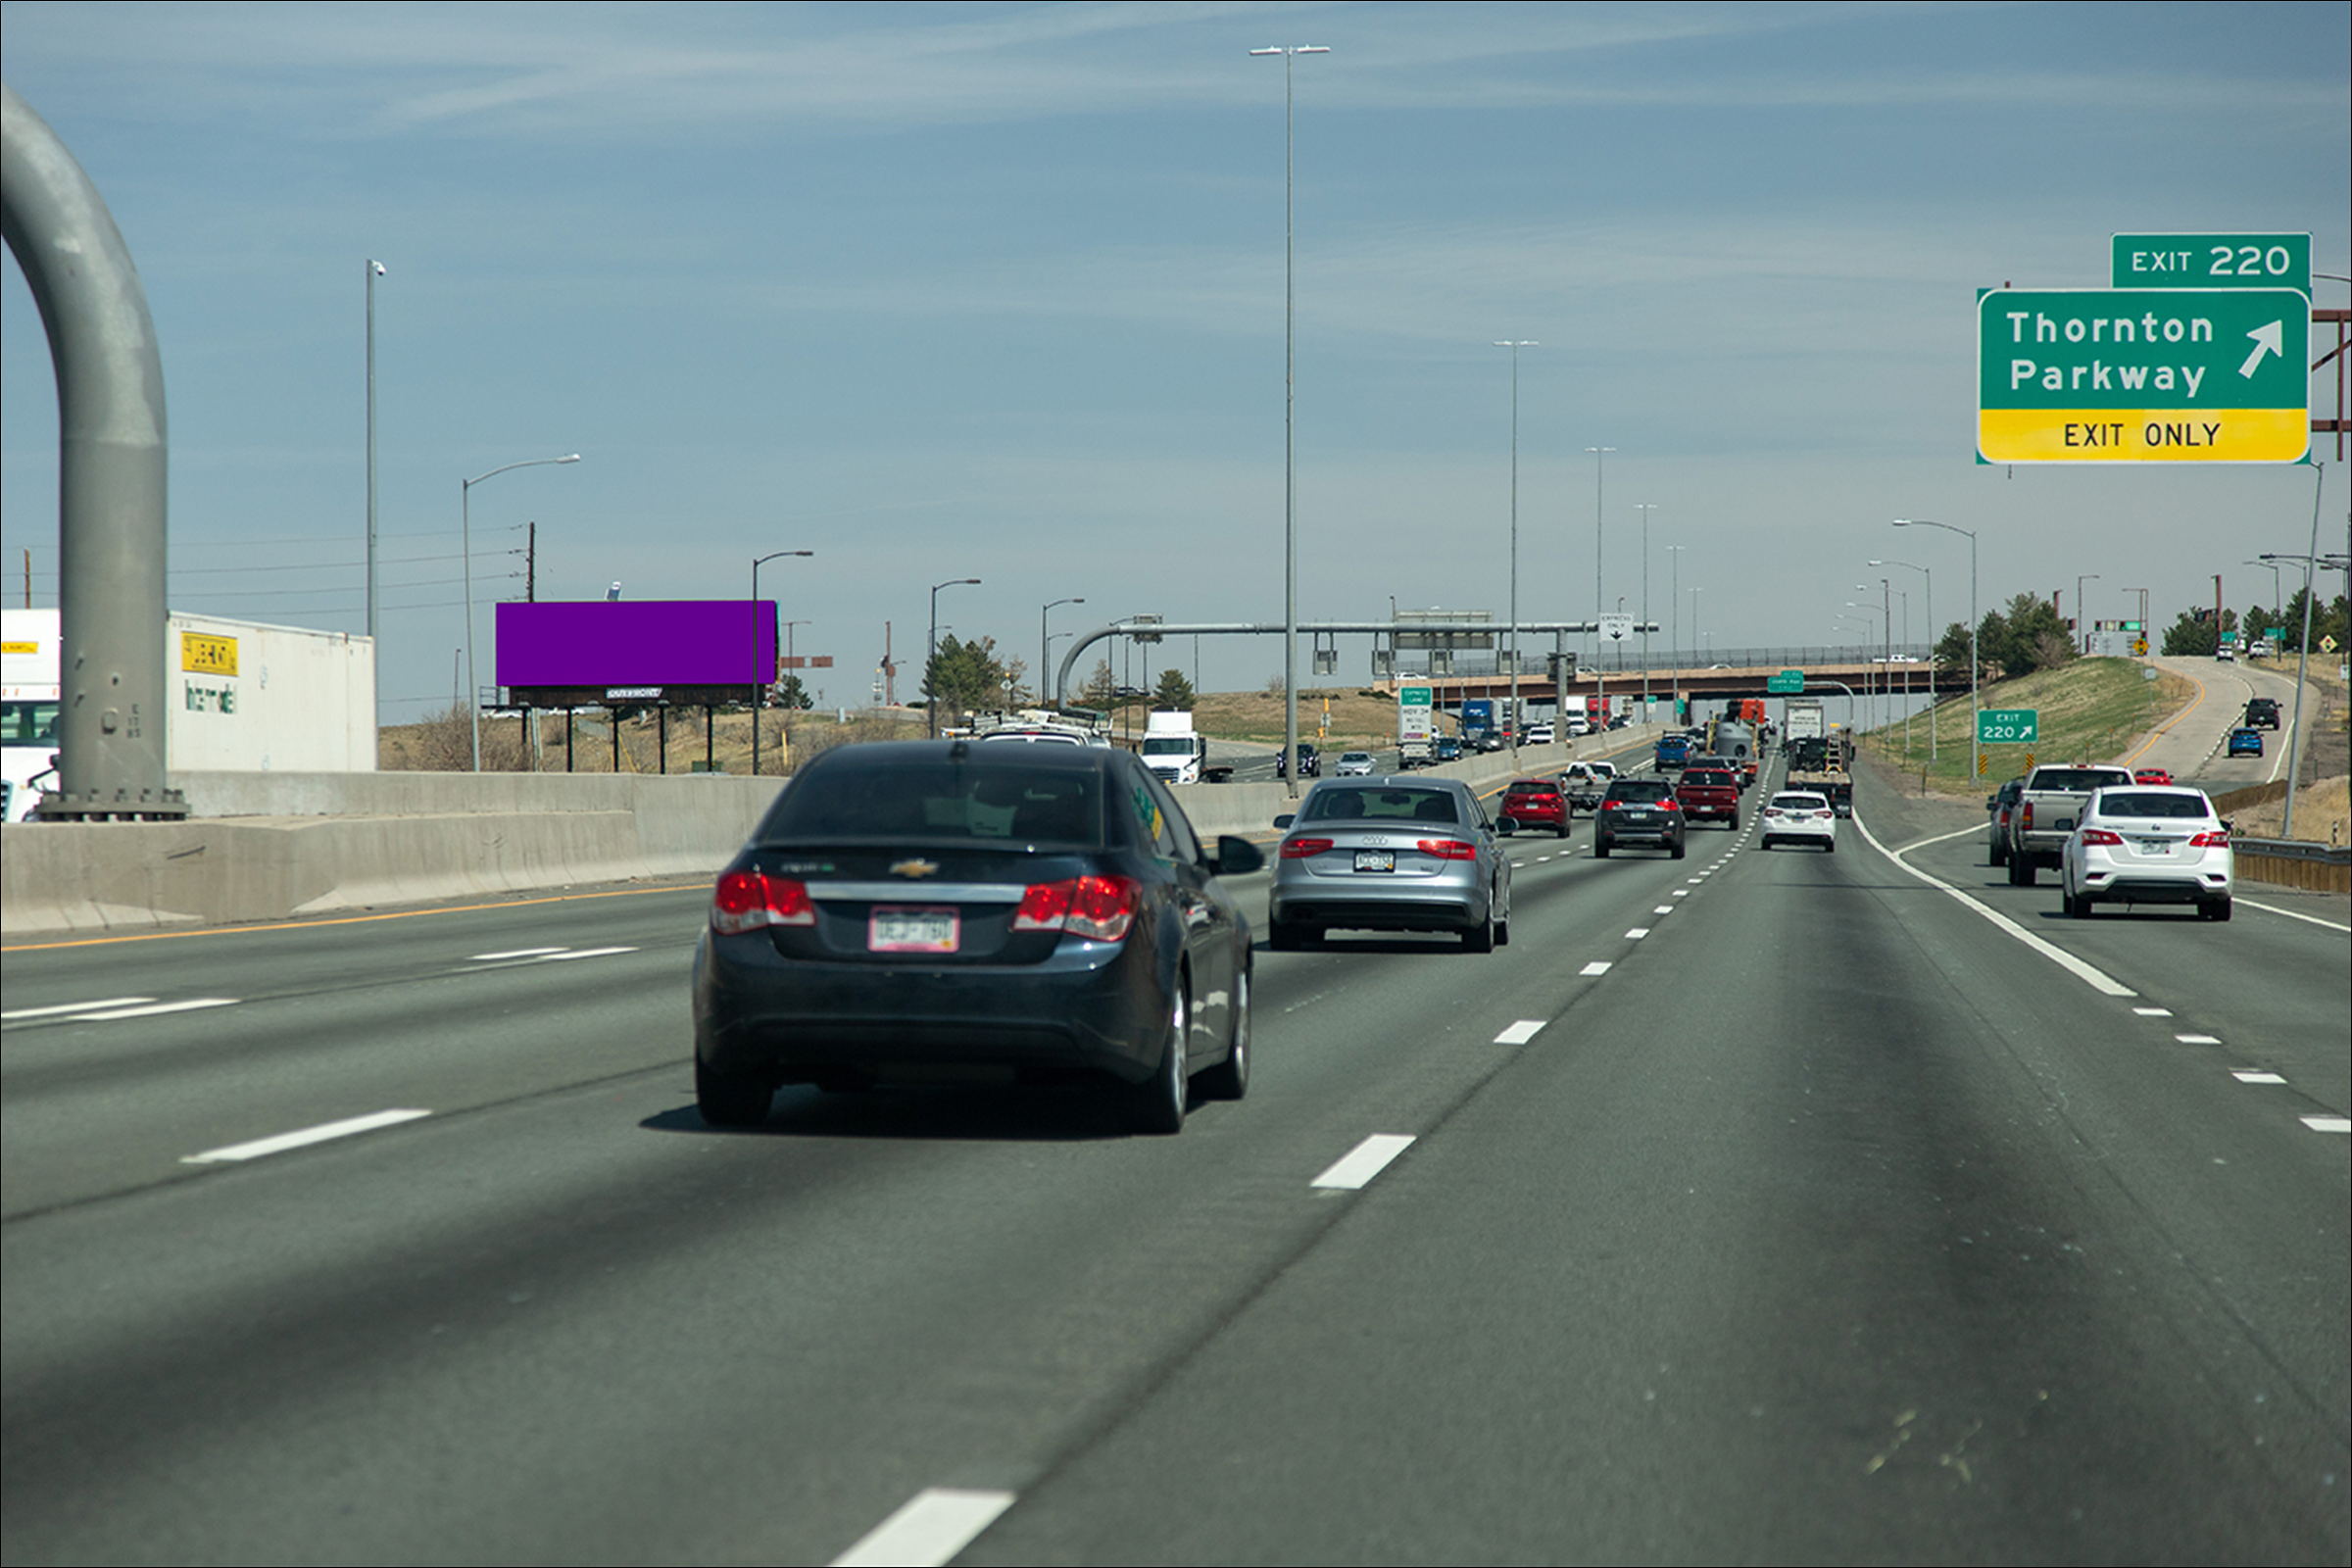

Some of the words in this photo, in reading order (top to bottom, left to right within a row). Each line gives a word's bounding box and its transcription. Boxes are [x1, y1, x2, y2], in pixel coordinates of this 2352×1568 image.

[2132, 252, 2192, 271] EXIT
[2209, 245, 2290, 276] 220
[2006, 311, 2214, 342] Thornton
[2010, 359, 2206, 398] Parkway
[2065, 423, 2125, 447] EXIT
[2145, 422, 2222, 447] ONLY
[1984, 725, 2015, 738] 220
[1996, 713, 2020, 722] EXIT
